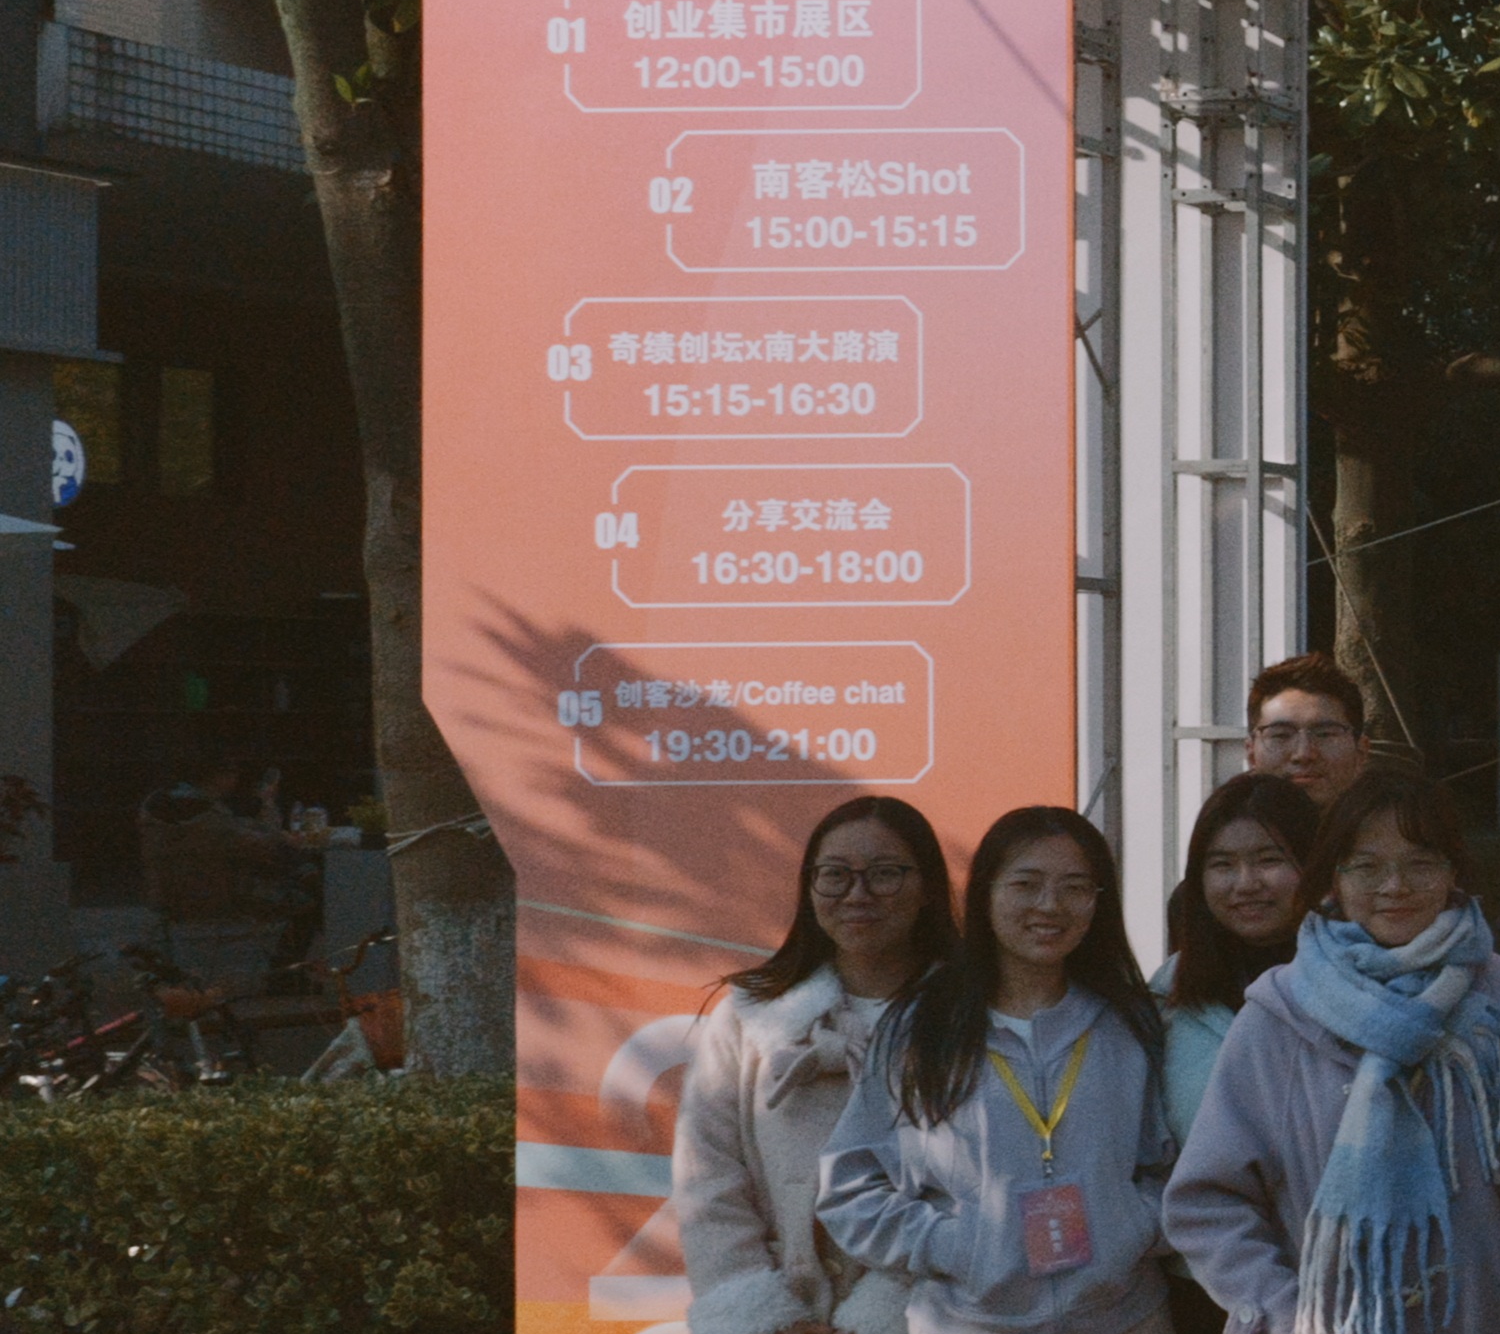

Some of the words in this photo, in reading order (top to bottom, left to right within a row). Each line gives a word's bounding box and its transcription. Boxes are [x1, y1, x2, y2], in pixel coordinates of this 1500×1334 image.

[547, 17, 586, 54] 01
[634, 54, 866, 89] 12:00-15:00
[648, 176, 694, 214] 02
[752, 158, 972, 200] 南客松Shot
[746, 214, 978, 249] 15:00-15:15
[547, 343, 593, 382] 03
[608, 329, 900, 365] 奇绩创坛x南大路演
[644, 382, 877, 417] 15:15-16:30
[595, 511, 639, 550] 04
[722, 497, 893, 533] 分享交流会
[691, 550, 925, 586] 16:30-18:00
[557, 689, 603, 728] 05
[843, 680, 906, 705] chat
[644, 728, 878, 764] 19:30-21:00
